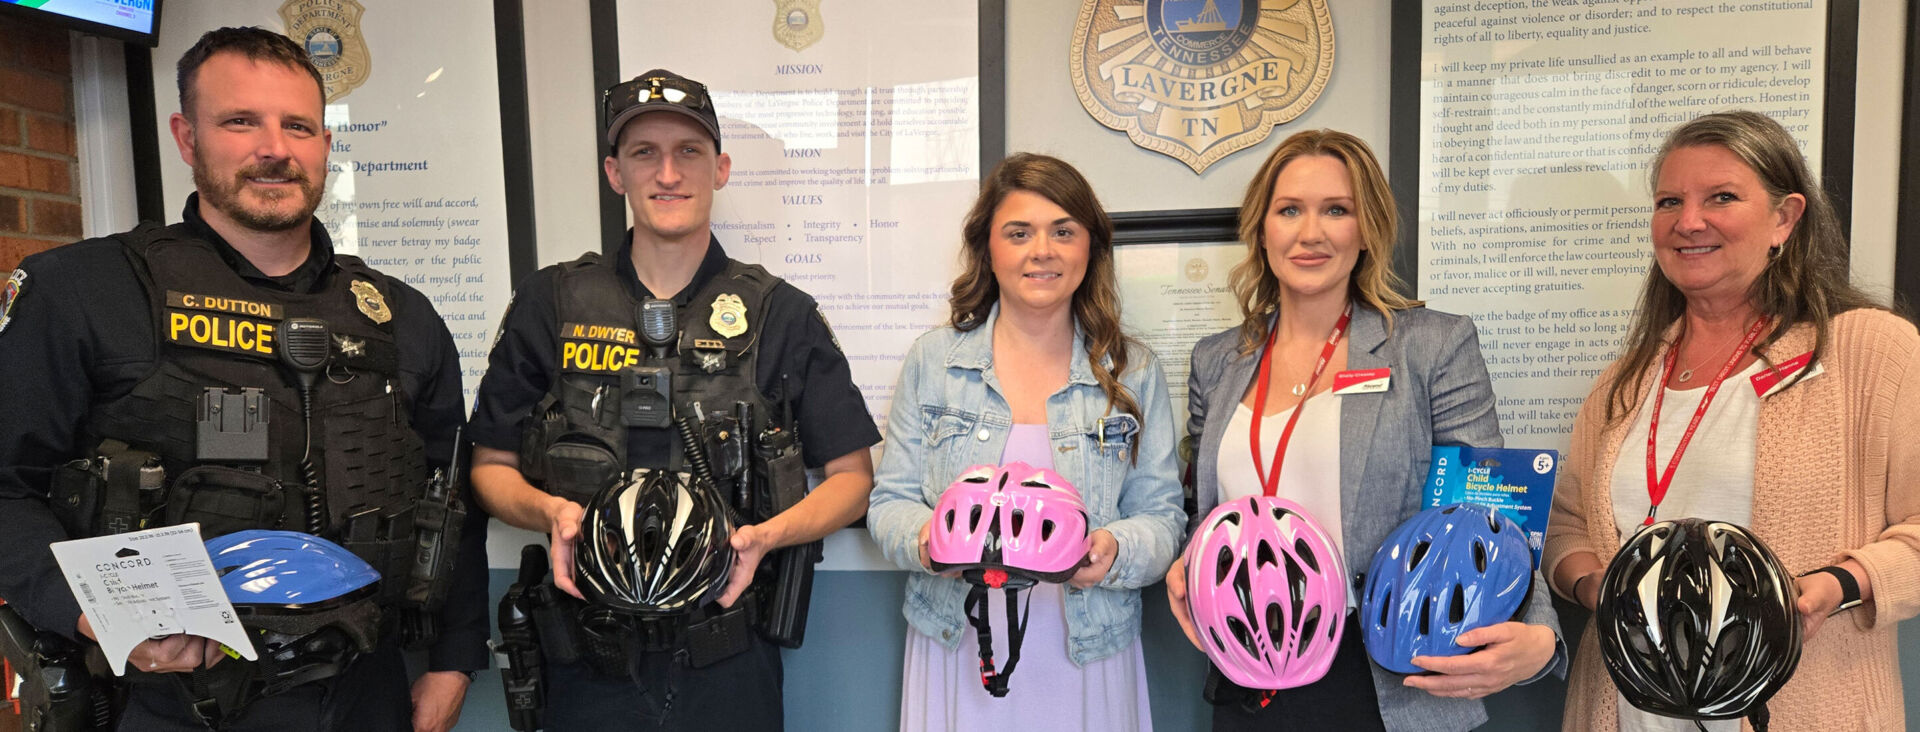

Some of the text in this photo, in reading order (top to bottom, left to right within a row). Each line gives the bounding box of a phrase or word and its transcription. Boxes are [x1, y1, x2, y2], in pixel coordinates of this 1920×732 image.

[299, 0, 344, 12] POLICE
[1434, 1, 1528, 16] against deception,
[292, 10, 351, 30] DEPARTMENT
[1434, 0, 1813, 31] peaceful against violence or disorder; and to respect the constitutional
[1176, 33, 1227, 49] COMMERCE
[1434, 23, 1652, 46] rights of all to liberty, equality and justice.
[1152, 23, 1250, 64] TENNESSEE
[1441, 61, 1460, 72] will
[1463, 60, 1487, 74] keep
[1490, 61, 1507, 73] my
[1509, 58, 1546, 73] private
[1548, 56, 1565, 68] life
[1568, 53, 1616, 66] unsullied
[1620, 55, 1631, 64] as
[1634, 55, 1647, 63] an
[1650, 49, 1695, 64] example
[1698, 50, 1709, 60] to
[1711, 47, 1724, 59] all
[1728, 46, 1748, 58] and
[1752, 45, 1771, 56] will
[1774, 44, 1812, 56] behave
[321, 67, 353, 80] ERGNE
[775, 64, 823, 75] MISSION
[1122, 61, 1279, 102] LAVERGNE
[1181, 117, 1220, 137] TN
[783, 148, 822, 158] VISION
[353, 160, 428, 176] Department
[1432, 181, 1497, 195] of my duties.
[382, 199, 400, 213] free
[403, 198, 422, 208] will
[424, 198, 443, 208] and
[445, 198, 479, 210] accord,
[782, 195, 823, 205] VALUES
[1437, 206, 1609, 222] will never act officiously or permit
[382, 217, 480, 231] and solemnly (swear
[803, 220, 841, 231] Integrity
[870, 219, 899, 229] Honor
[1431, 222, 1602, 237] beliefs, aspirations, animosities or
[372, 236, 480, 249] never betray my badge
[744, 233, 864, 245] Respect Transparency
[415, 257, 425, 265] or
[431, 254, 446, 265] the
[452, 254, 482, 268] public
[785, 254, 822, 264] GOALS
[430, 273, 484, 287] myself and
[784, 272, 809, 282] highest
[1160, 284, 1203, 296] Tennessee
[1430, 281, 1585, 296] and never accepting gratuities.
[433, 292, 484, 305] uphold the
[182, 294, 272, 318] C. DUTTON
[468, 312, 486, 321] and
[1487, 308, 1619, 322] the badge of my office as a
[170, 312, 274, 354] POLICE
[573, 324, 635, 344] N. DWYER
[1480, 338, 1498, 349] will
[1503, 341, 1531, 349] never
[1535, 339, 1570, 351] engage
[1575, 337, 1585, 347] in
[1589, 337, 1609, 347] acts
[563, 341, 640, 372] POLICE
[1498, 396, 1545, 406] alone am
[1519, 409, 1560, 420] will take
[1517, 424, 1529, 435] of
[1537, 460, 1550, 471] 5+
[1432, 457, 1448, 507] NCORD
[1467, 474, 1489, 483] Child
[1465, 482, 1528, 493] Bicycle Helmet
[95, 557, 151, 572] CONCORD
[131, 582, 159, 591] Helmet
